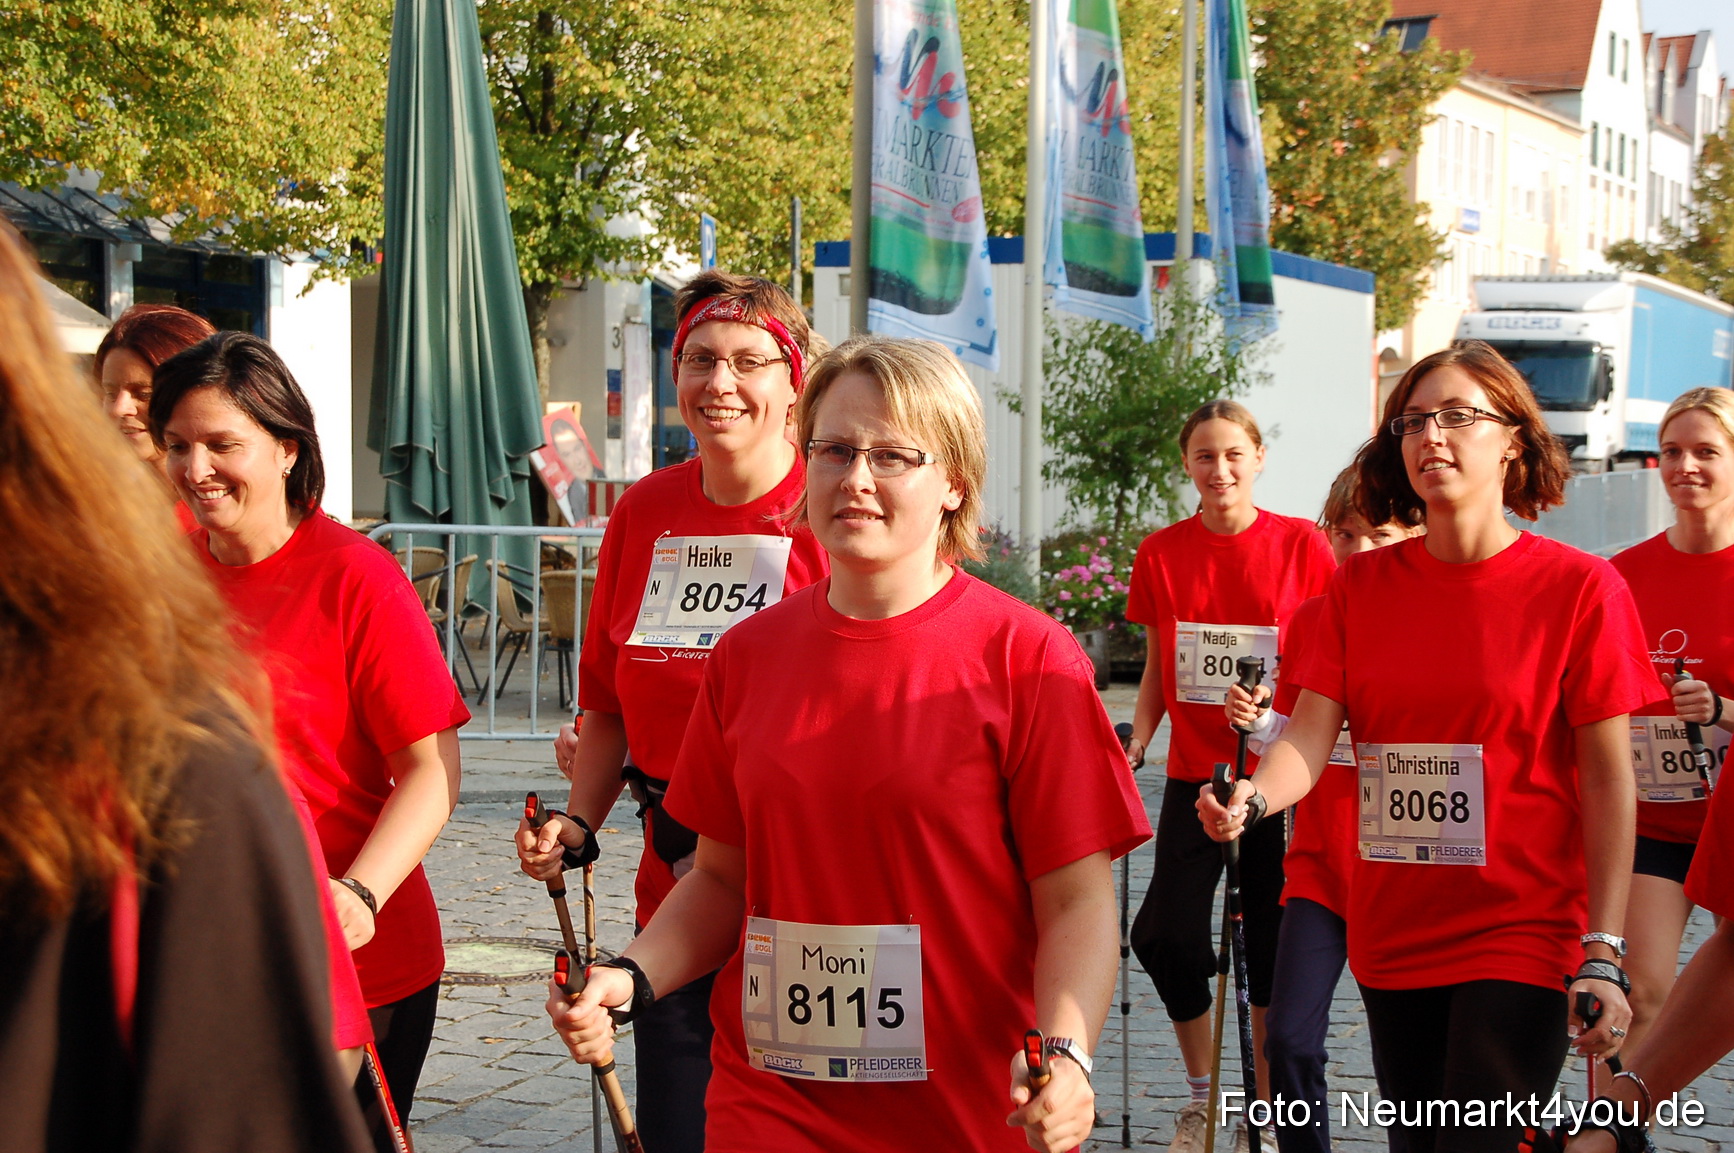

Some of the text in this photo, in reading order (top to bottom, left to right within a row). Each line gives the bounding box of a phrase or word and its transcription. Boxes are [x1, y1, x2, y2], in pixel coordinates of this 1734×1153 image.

[611, 326, 621, 349] 3
[687, 545, 732, 568] Heike
[650, 580, 661, 595] N
[680, 582, 768, 613] 8054
[1203, 630, 1237, 649] Nadja
[1180, 652, 1186, 663] N
[1386, 752, 1460, 775] Christina
[1633, 749, 1642, 761] N
[1363, 786, 1371, 802] N
[1389, 789, 1470, 824] 8068
[1430, 845, 1483, 858] PFLEIDERER
[802, 944, 866, 975] Moni
[749, 975, 759, 997] N
[787, 983, 905, 1030] 8115
[763, 1054, 803, 1070] BOCK
[850, 1057, 922, 1070] PFLEIDERER
